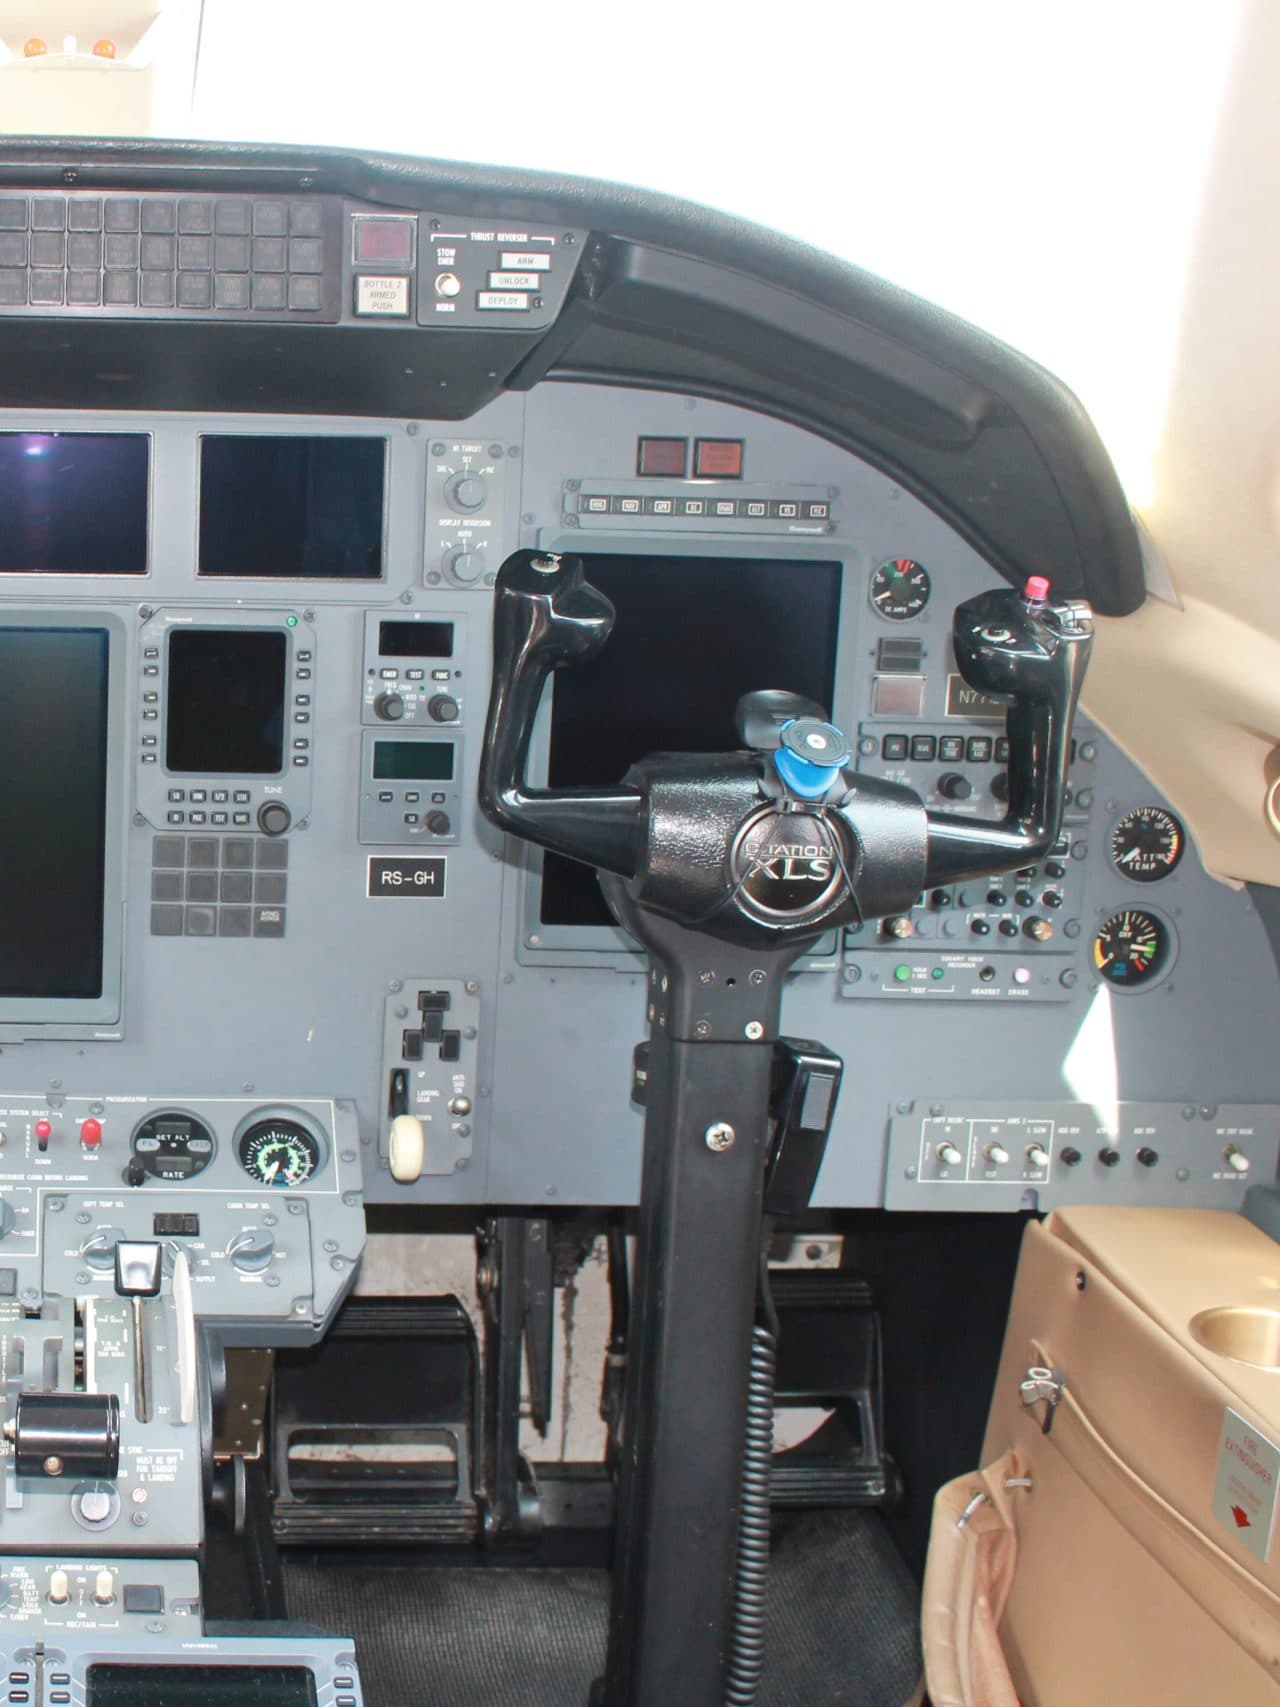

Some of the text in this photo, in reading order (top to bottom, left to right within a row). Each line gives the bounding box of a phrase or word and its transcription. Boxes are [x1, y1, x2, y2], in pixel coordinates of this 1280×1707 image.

[471, 232, 528, 242] THRUST REVERSER
[437, 249, 456, 257] STOW
[364, 280, 395, 288] BOTTLE
[498, 277, 529, 285] UNLOCK
[369, 291, 396, 299] ARMED
[488, 297, 518, 305] DEPLOY
[372, 302, 393, 310] PUSH
[744, 842, 833, 857] CTATION
[749, 857, 830, 881] XLS
[1129, 862, 1156, 870] TEMP
[381, 871, 435, 885] RS-GH
